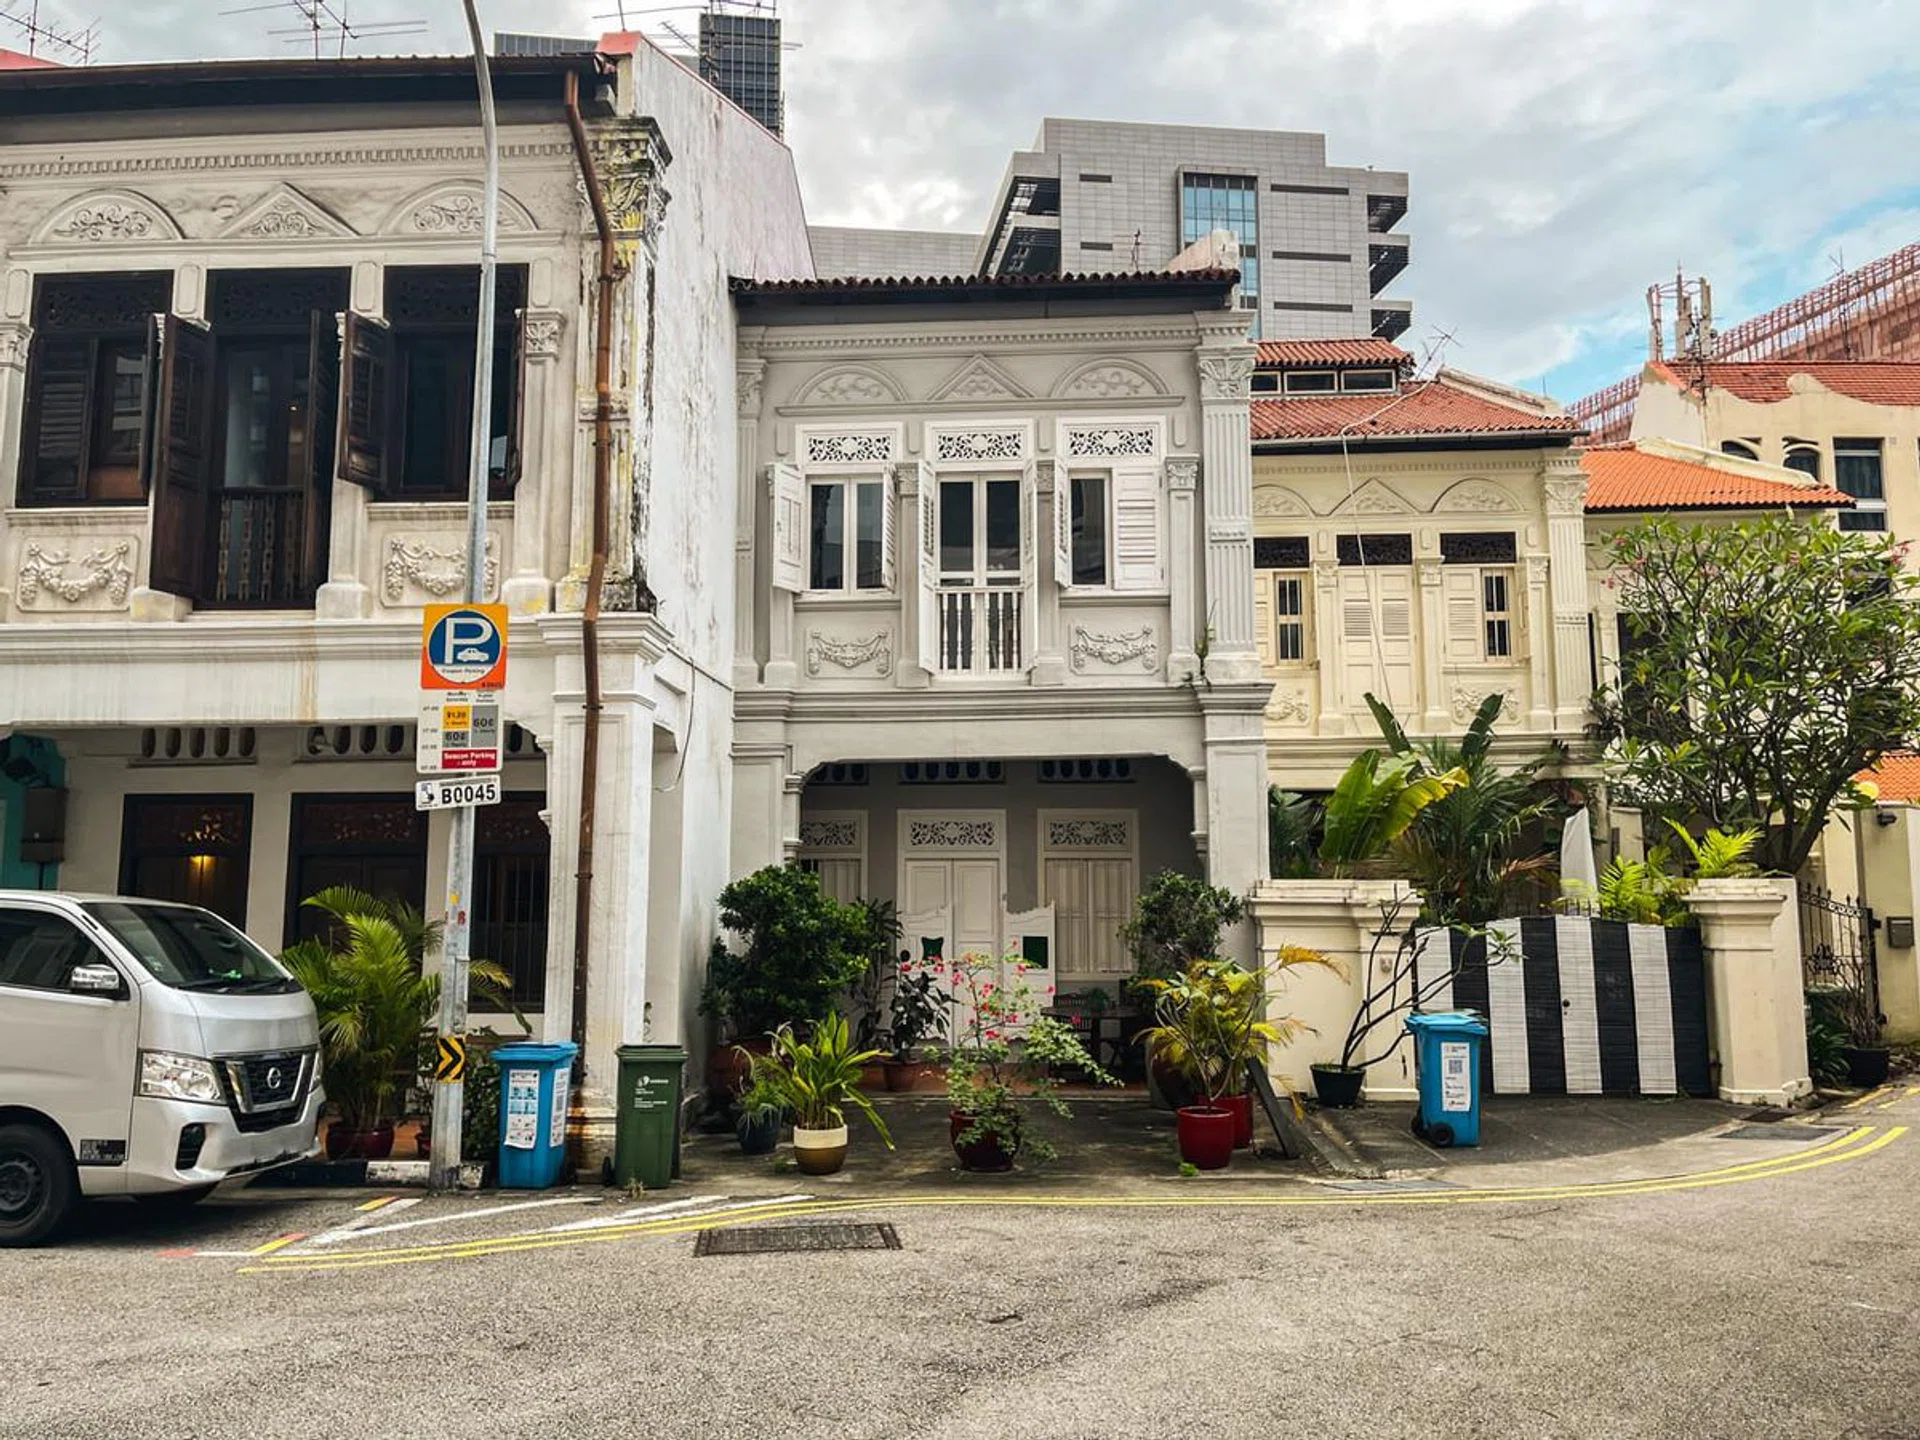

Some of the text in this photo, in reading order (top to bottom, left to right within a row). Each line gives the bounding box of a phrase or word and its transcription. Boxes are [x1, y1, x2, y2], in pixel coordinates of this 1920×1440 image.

[444, 617, 493, 666] P
[470, 752, 496, 760] Parking
[442, 784, 496, 804] B0045
